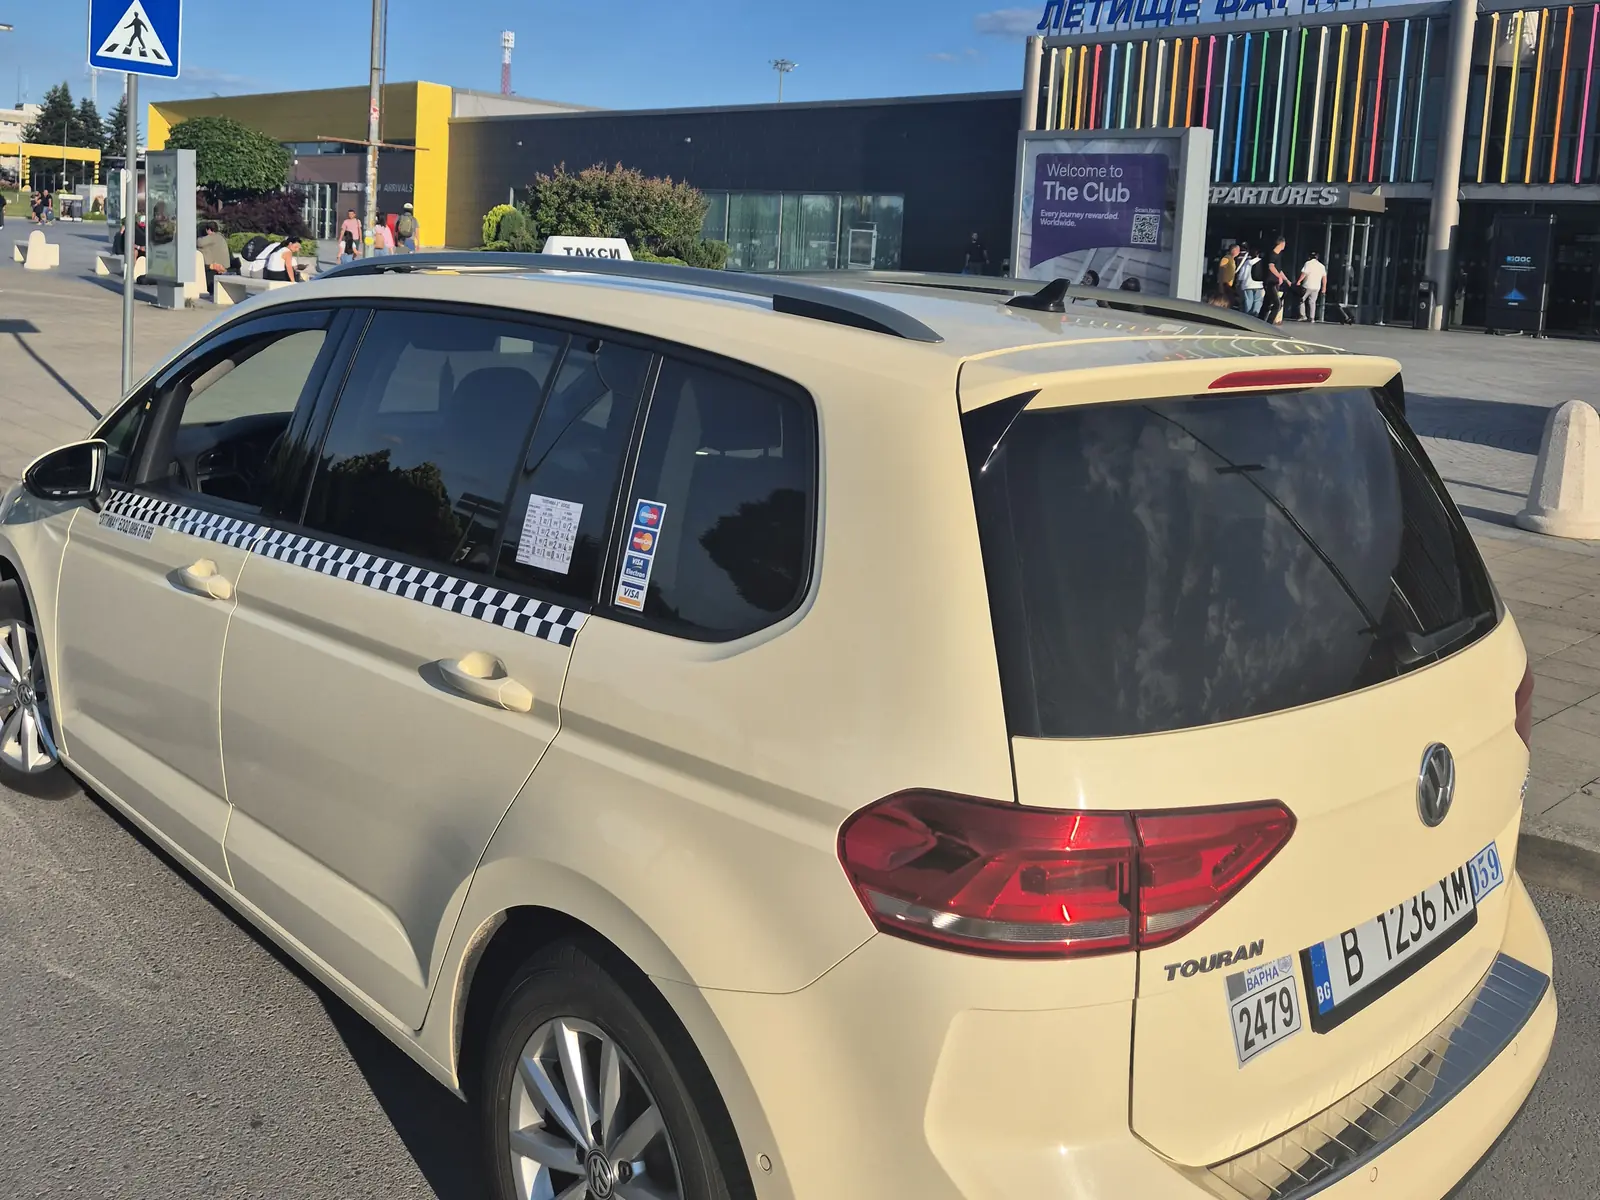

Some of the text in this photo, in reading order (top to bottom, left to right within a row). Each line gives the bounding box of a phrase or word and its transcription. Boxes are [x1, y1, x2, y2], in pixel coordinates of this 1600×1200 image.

[1047, 164, 1123, 178] Welcome to
[383, 184, 413, 192] ARRIVALS
[1043, 181, 1130, 203] The Club
[1208, 186, 1339, 205] PARTURES
[1040, 210, 1060, 219] Every
[1059, 211, 1084, 220] journey
[1040, 218, 1077, 227] Worldwide.
[563, 247, 620, 259] ТАКСИ
[632, 557, 644, 567] VISA
[626, 569, 646, 578] Electron
[623, 587, 640, 600] VISA
[1470, 849, 1500, 896] 059
[1340, 927, 1364, 986] B
[1376, 890, 1437, 961] 1236
[1164, 938, 1265, 982] TOURAN
[1246, 966, 1280, 992] ВАРНА
[1316, 981, 1332, 1004] BG
[1239, 986, 1294, 1051] 2479
